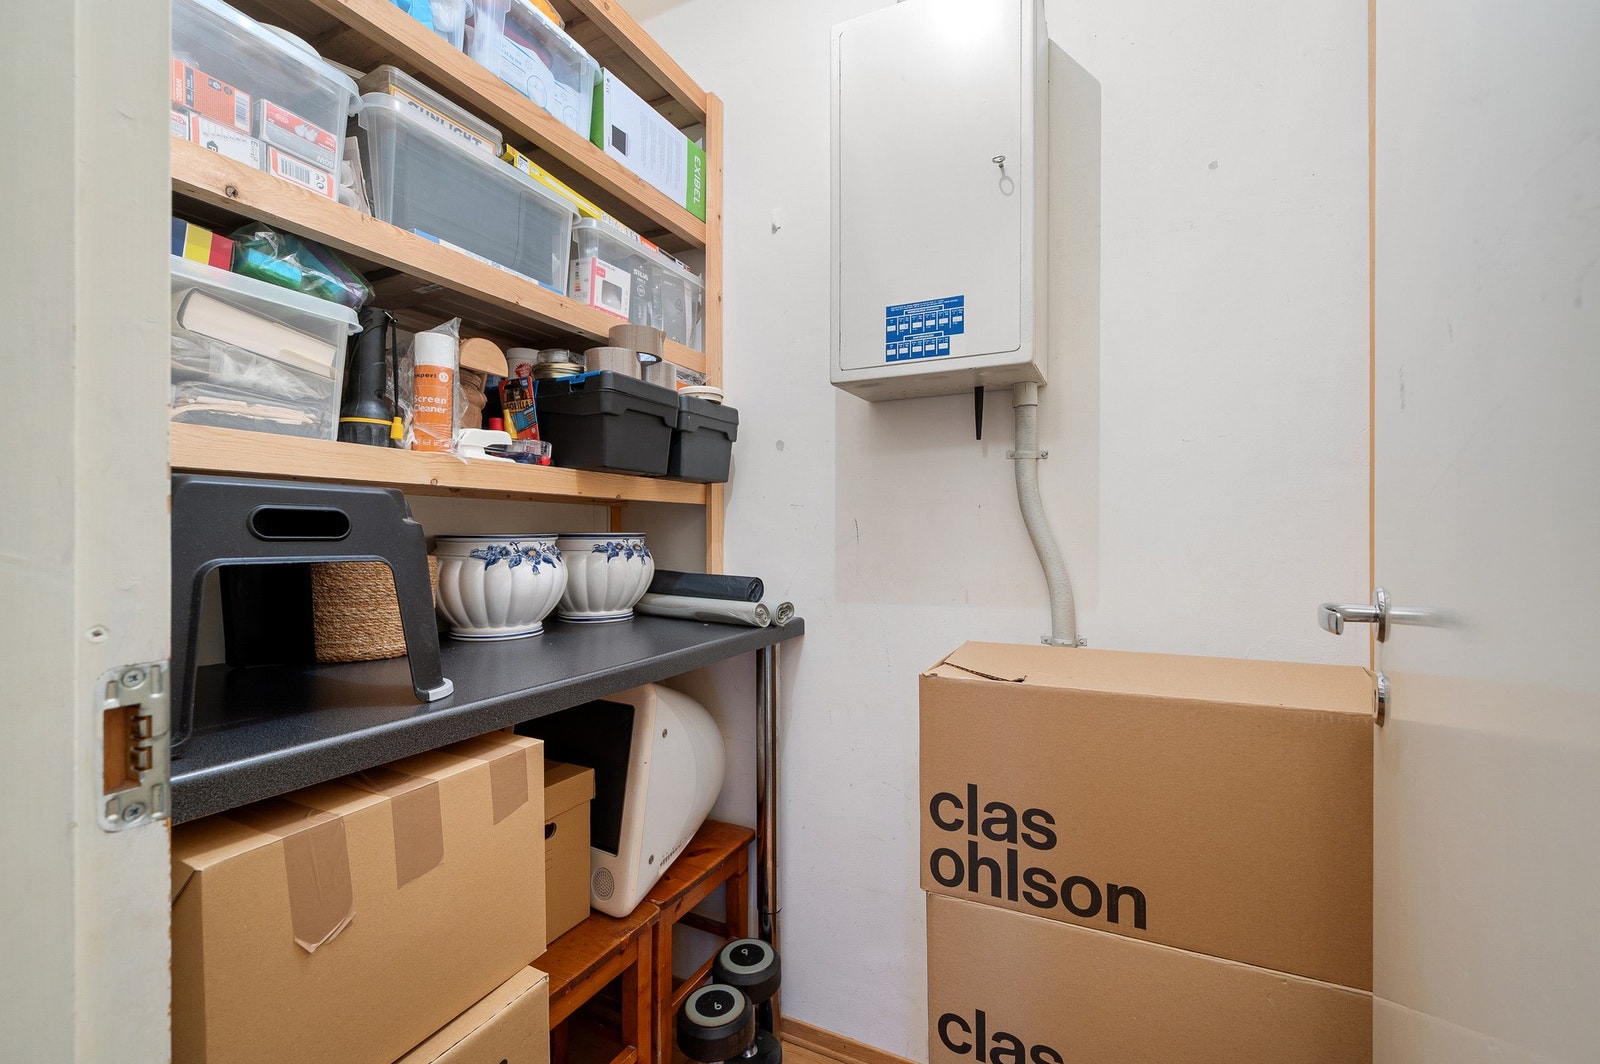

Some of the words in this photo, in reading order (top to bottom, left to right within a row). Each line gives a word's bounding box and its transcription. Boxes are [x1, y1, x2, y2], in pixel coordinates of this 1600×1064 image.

[694, 155, 702, 204] EXIBEL
[414, 394, 447, 405] Screen
[414, 403, 447, 414] Cleaner
[930, 783, 1058, 851] clas
[930, 840, 1147, 930] ohlson
